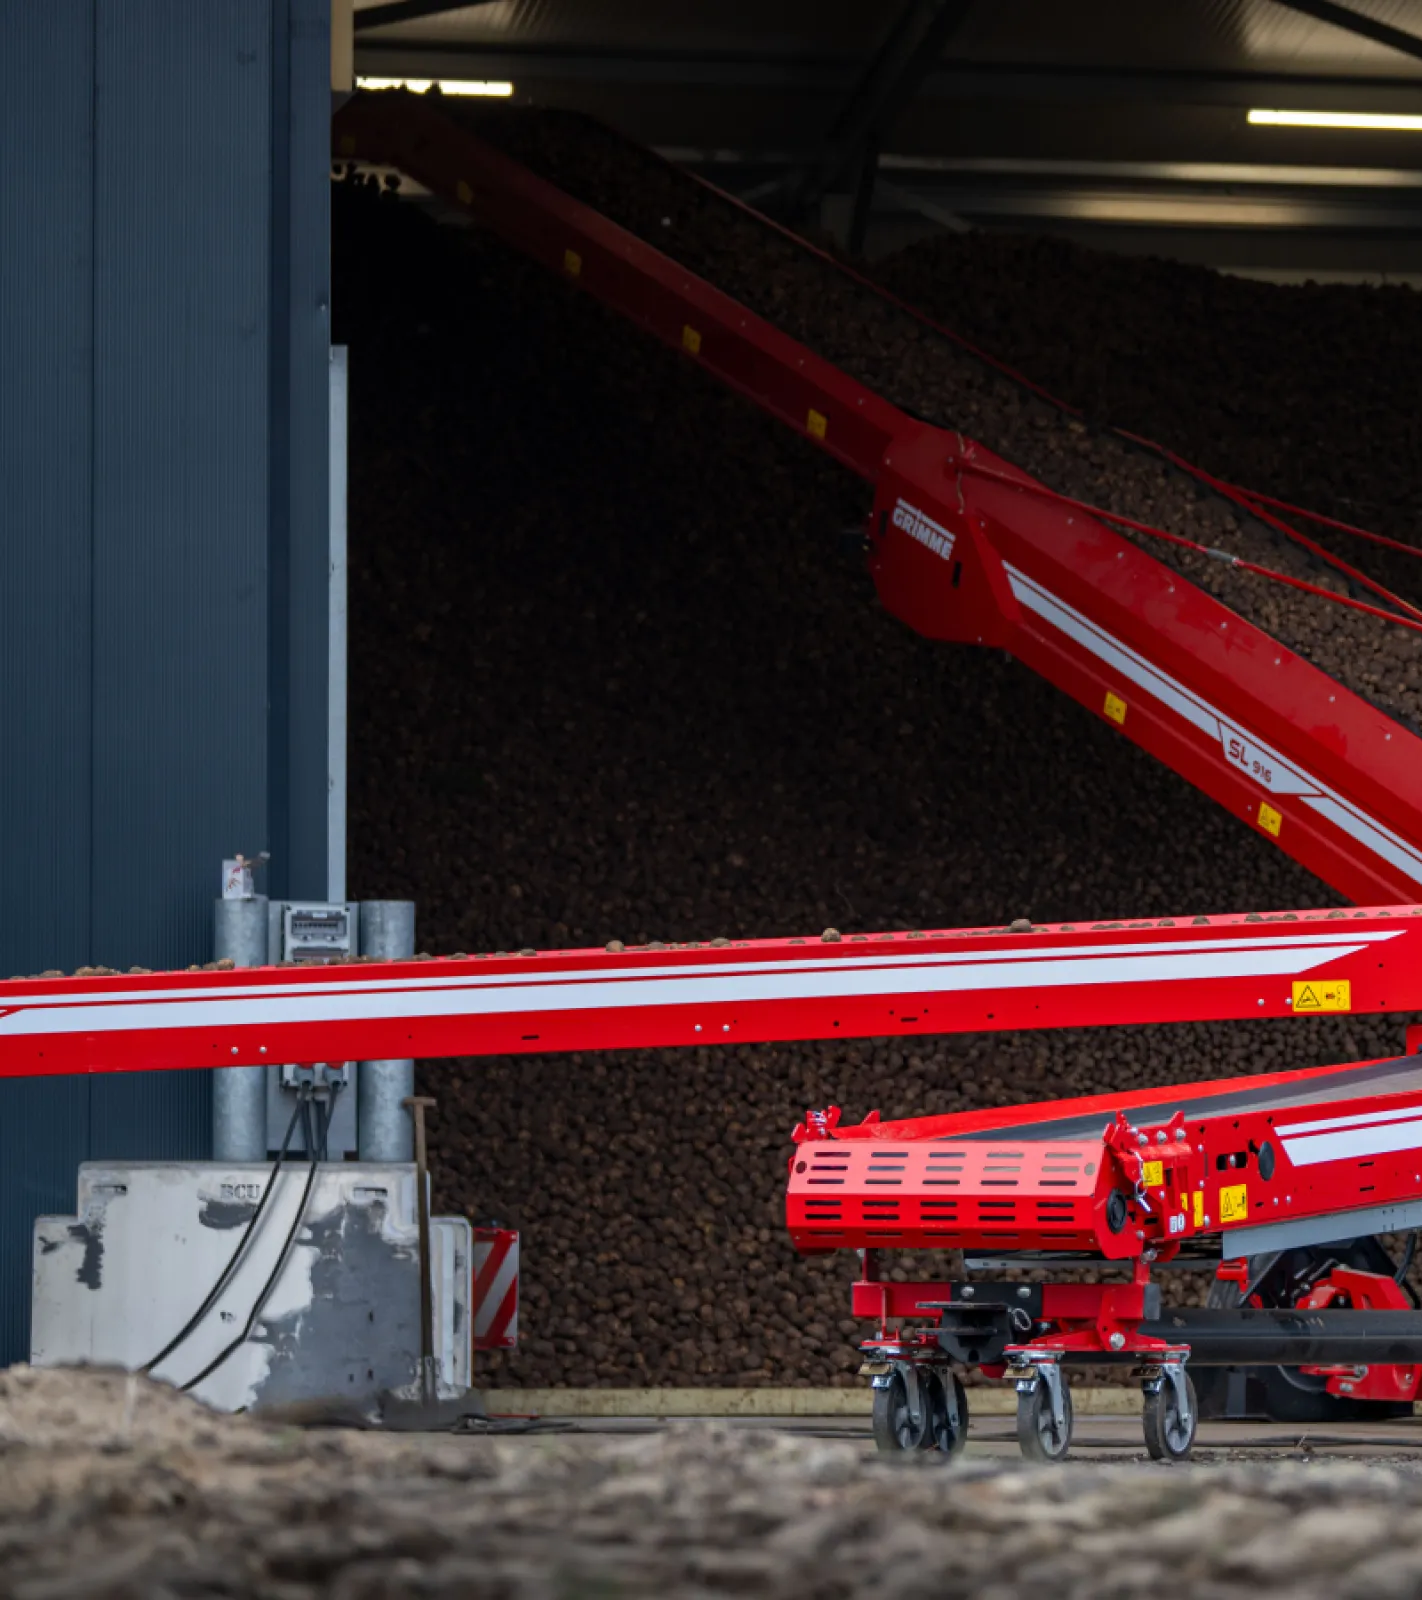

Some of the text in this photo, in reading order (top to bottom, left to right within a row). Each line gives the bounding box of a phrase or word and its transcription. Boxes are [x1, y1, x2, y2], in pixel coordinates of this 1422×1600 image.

[893, 504, 954, 560] GRIMME
[1228, 738, 1272, 783] SL 916
